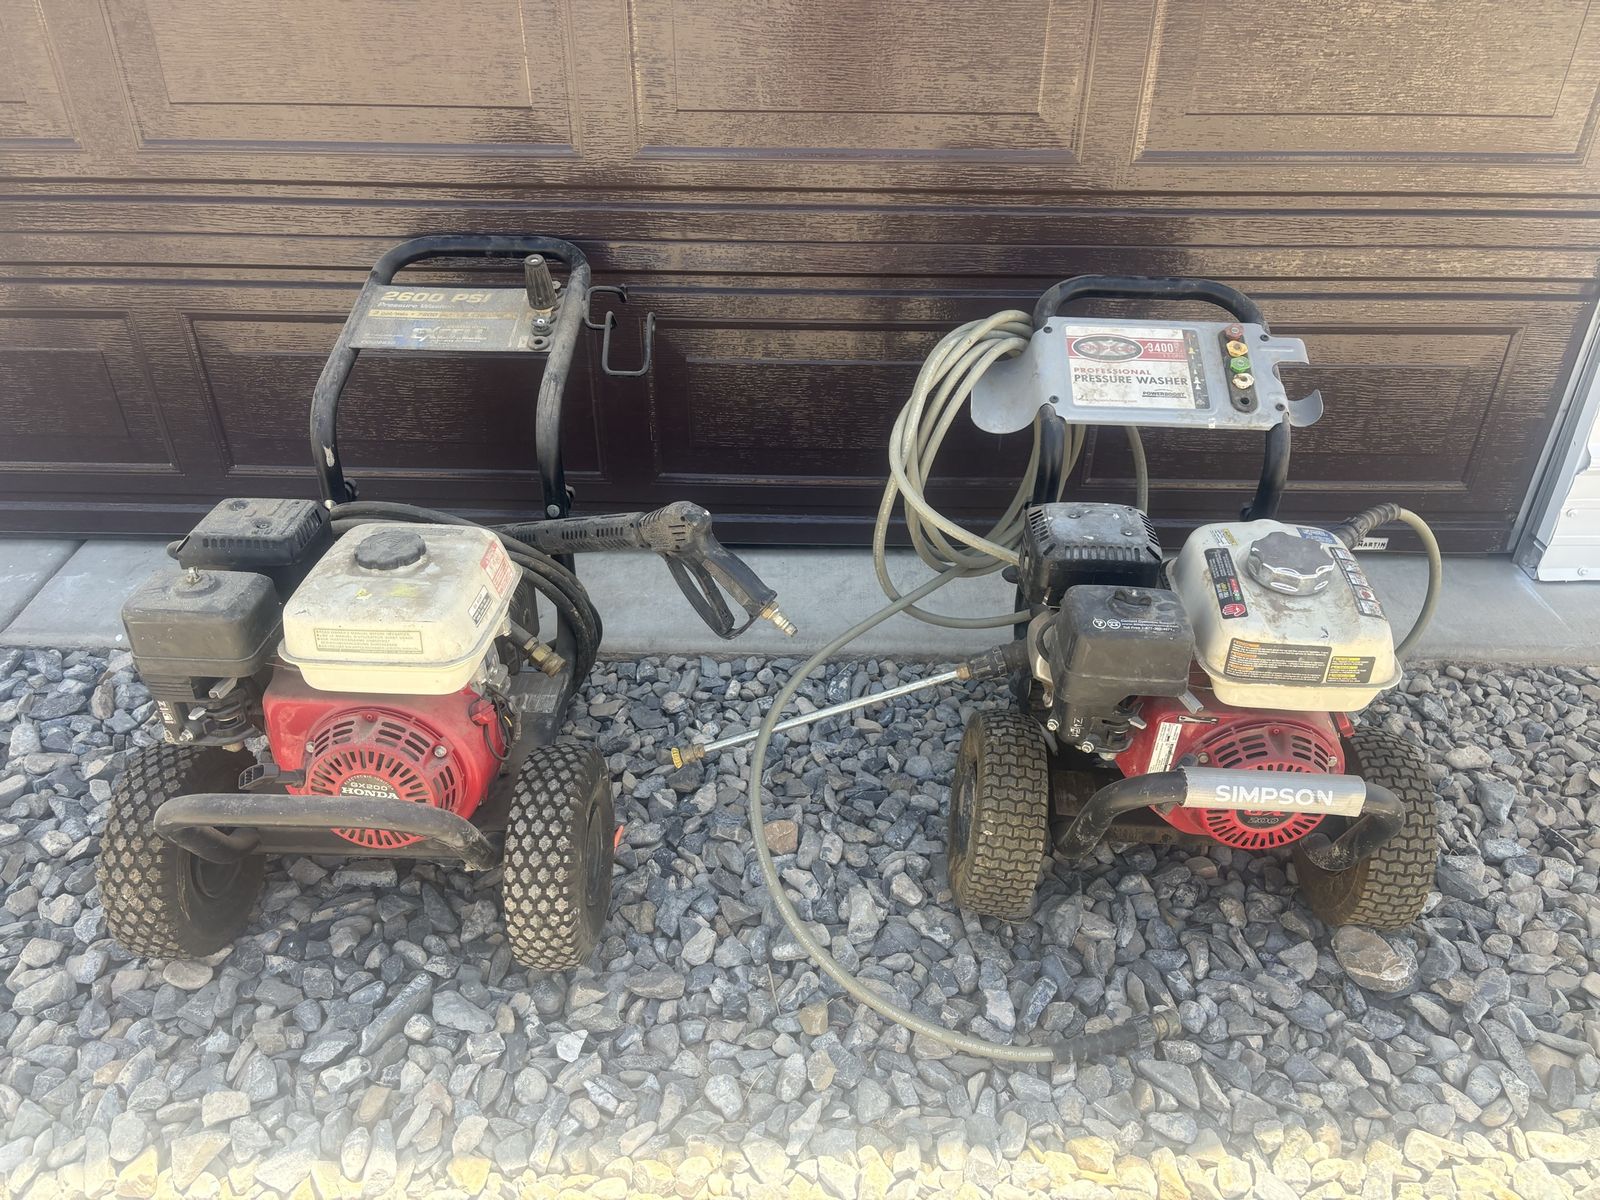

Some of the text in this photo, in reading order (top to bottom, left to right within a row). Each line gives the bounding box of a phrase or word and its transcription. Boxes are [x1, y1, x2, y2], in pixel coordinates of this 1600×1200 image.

[381, 291, 494, 304] 2600 PSI
[1147, 342, 1174, 353] 3400
[1073, 367, 1152, 376] PROFESSIONAL
[1074, 374, 1189, 386] PRESSURE WASHER
[341, 786, 400, 799] HONDA
[350, 782, 388, 791] GX200
[1215, 785, 1333, 806] SIMPSON
